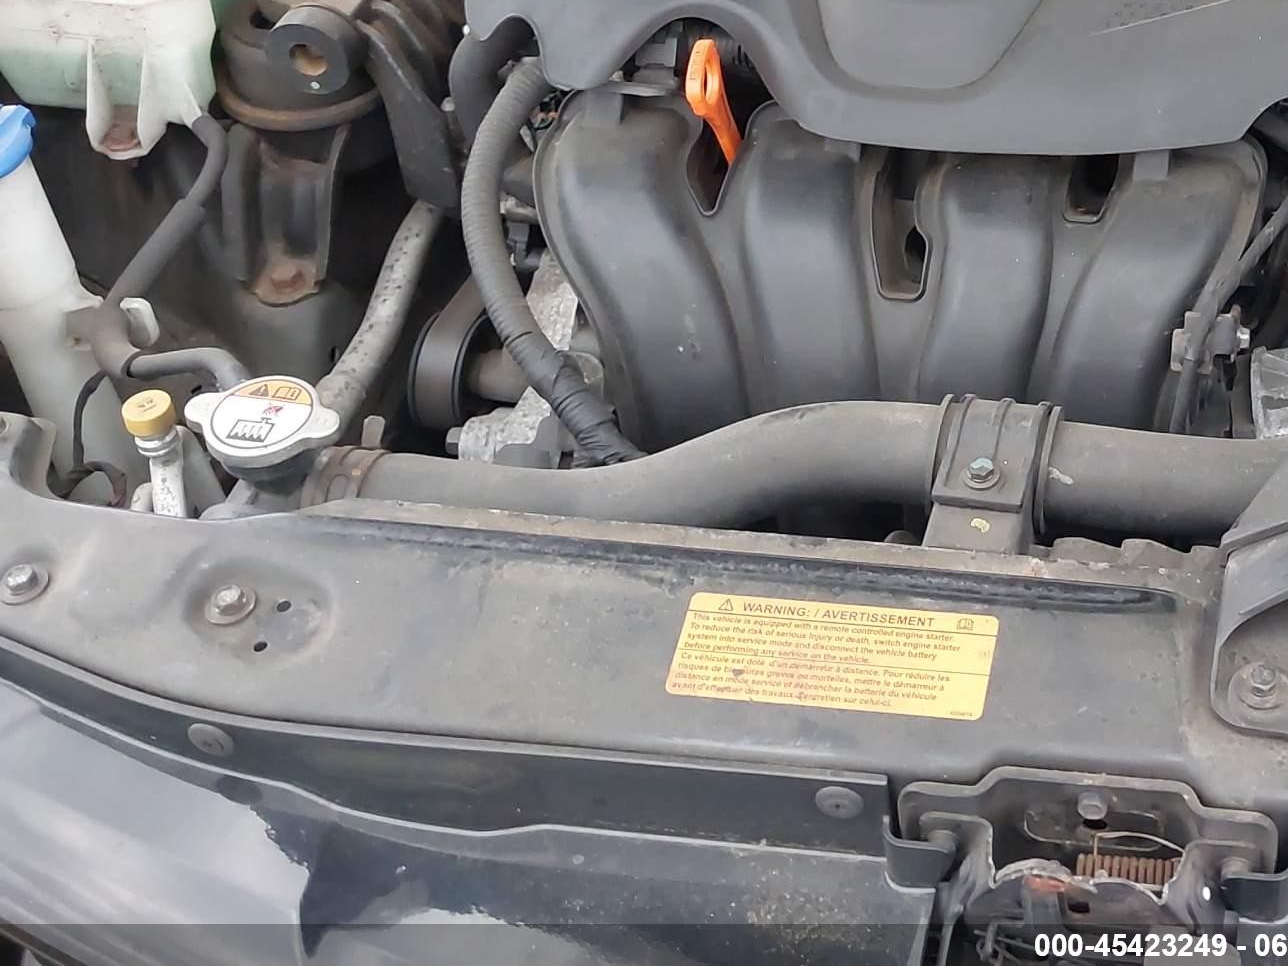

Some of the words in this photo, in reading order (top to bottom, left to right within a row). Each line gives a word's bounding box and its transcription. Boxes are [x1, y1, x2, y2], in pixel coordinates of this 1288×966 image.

[712, 615, 741, 623] vehicle
[752, 618, 792, 629] equipped
[793, 621, 811, 629] with
[820, 624, 849, 632] remote
[850, 627, 893, 636] controlled
[894, 631, 923, 640] engine
[742, 602, 811, 617] WARNING:
[821, 608, 934, 627] AVERTISSEMENT
[686, 632, 717, 642] system
[718, 634, 735, 642] into
[736, 636, 767, 645] service
[769, 639, 793, 647] mode
[811, 642, 858, 652] disconnect
[860, 646, 874, 654] the
[875, 648, 905, 656] vehicle
[906, 651, 937, 660] battery
[701, 623, 730, 632] reduce
[775, 629, 807, 638] serious
[873, 638, 901, 646] switch
[902, 641, 931, 650] engine
[932, 643, 960, 651] starter
